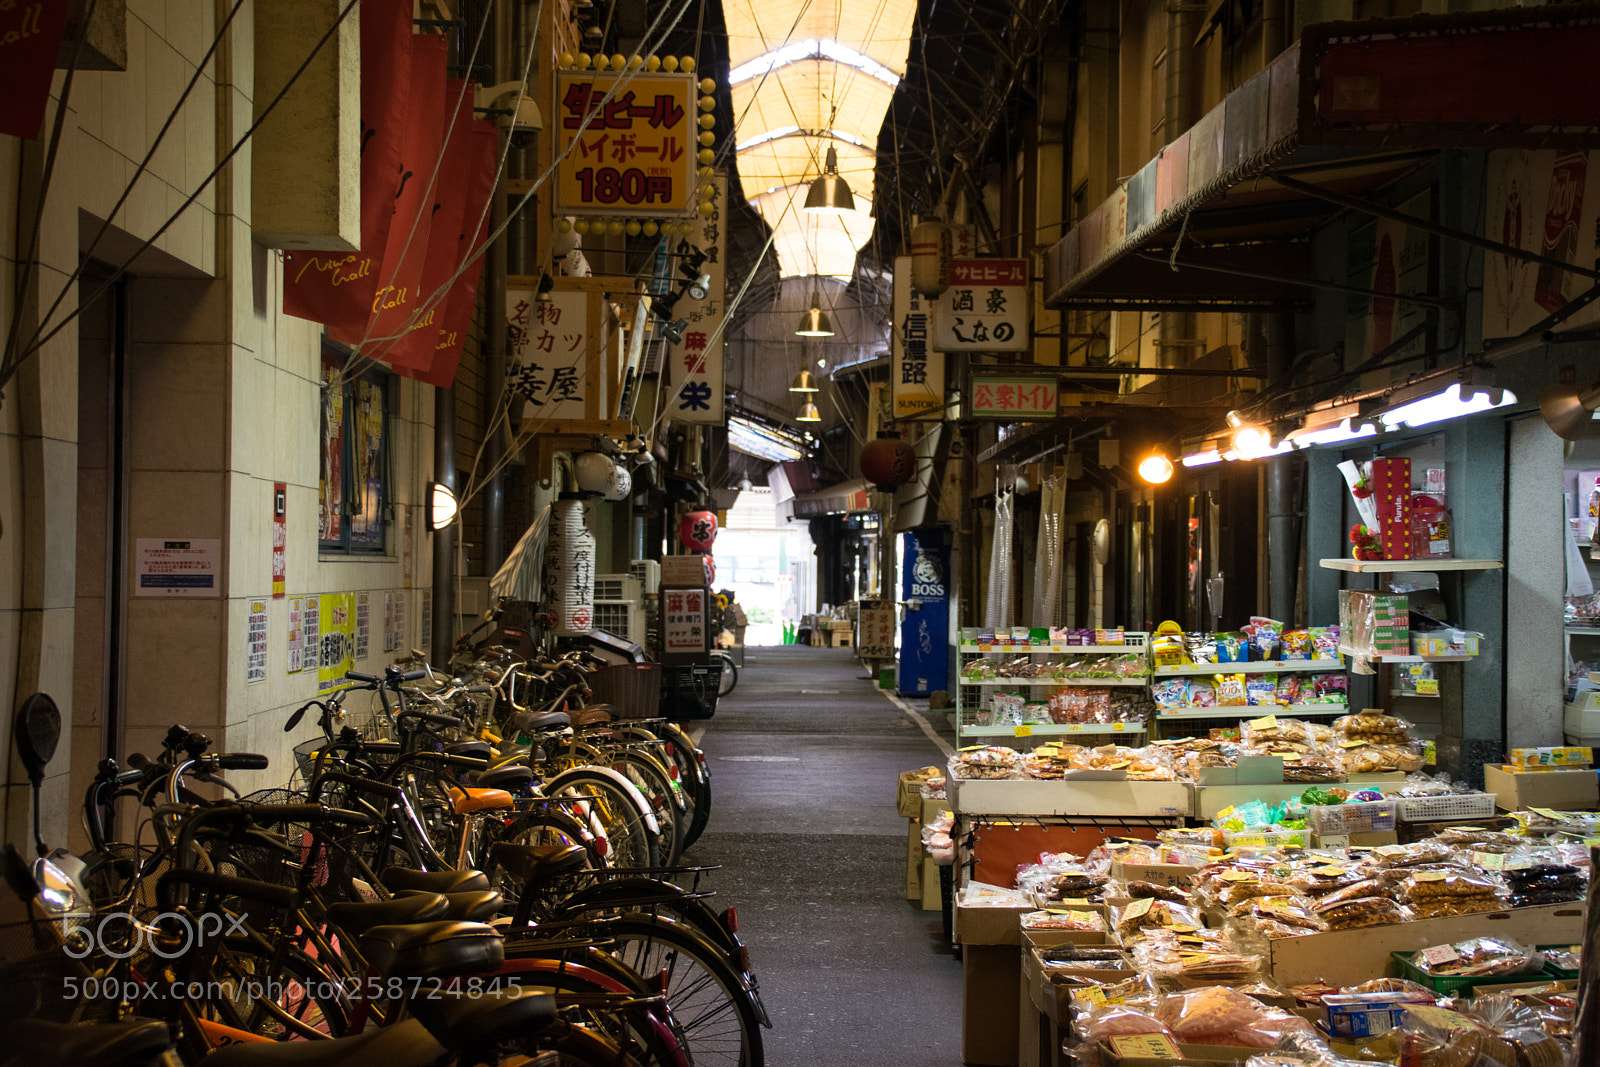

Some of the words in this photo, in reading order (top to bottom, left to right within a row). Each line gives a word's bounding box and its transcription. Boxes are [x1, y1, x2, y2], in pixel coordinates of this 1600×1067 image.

[563, 83, 684, 130] 生ビール
[565, 133, 684, 164] ハイボール
[575, 167, 672, 204] 180円
[952, 266, 1023, 281] サヒビール
[510, 300, 562, 326] 名物
[952, 288, 1007, 314] 酒豪
[951, 317, 1015, 343] しなの
[683, 332, 707, 374] 麻雀
[679, 381, 712, 412] 栄
[974, 384, 1055, 410] 公衆トイレ
[911, 584, 945, 596] BOSS
[668, 594, 701, 613] 麻雀
